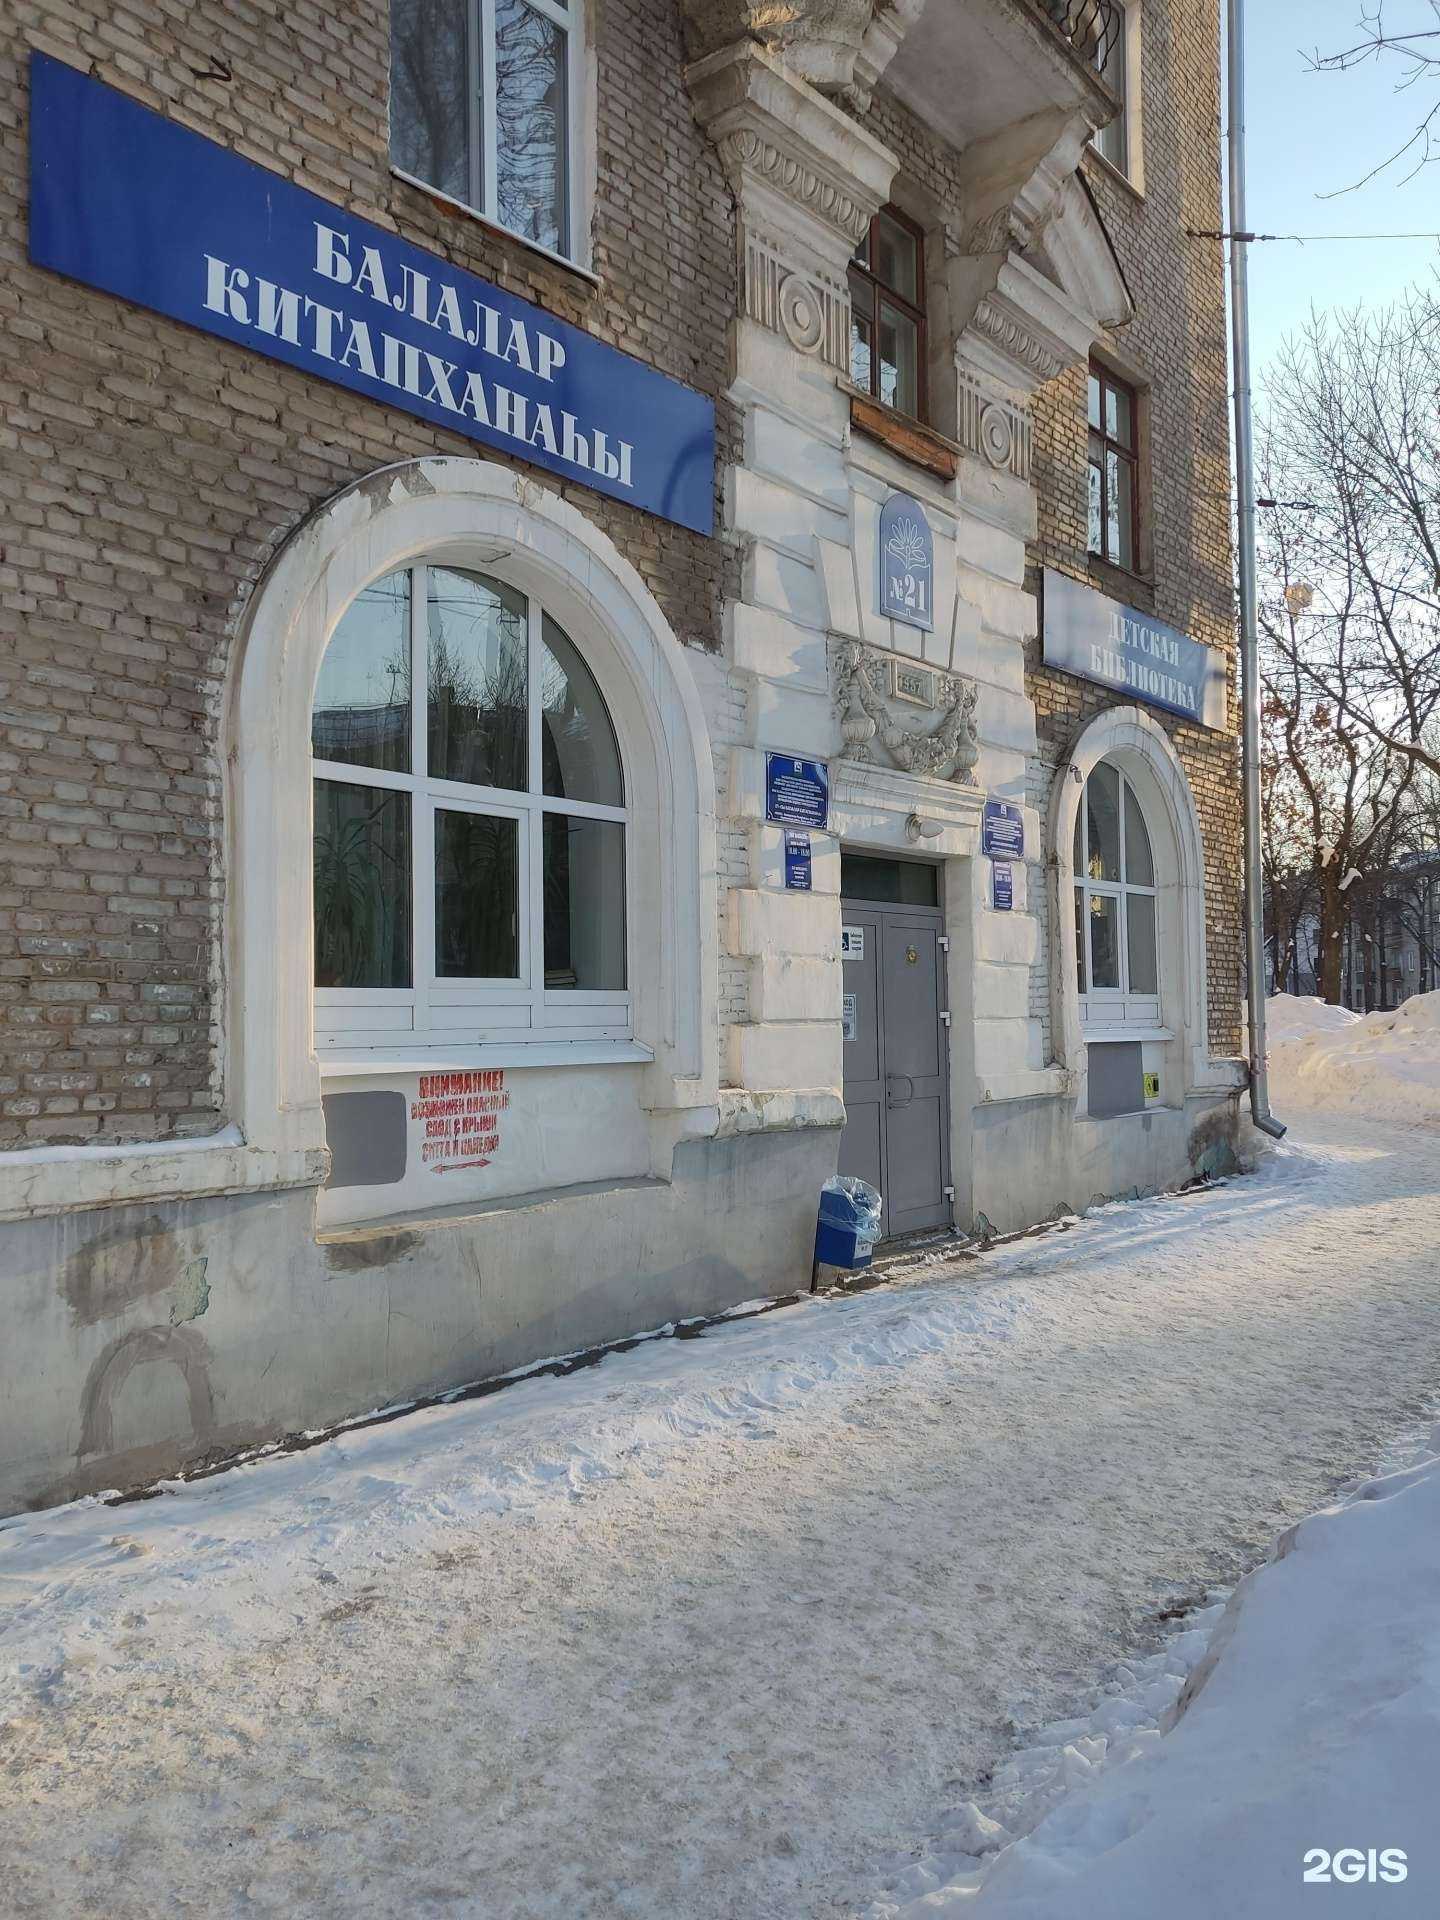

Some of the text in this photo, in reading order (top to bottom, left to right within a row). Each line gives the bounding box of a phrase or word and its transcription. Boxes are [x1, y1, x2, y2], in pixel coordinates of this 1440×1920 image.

[313, 221, 566, 383] БАЛАЛАР
[1108, 612, 1180, 667] ДЕТСКАЯ
[1090, 643, 1196, 711] БИБЛИОТЕКА
